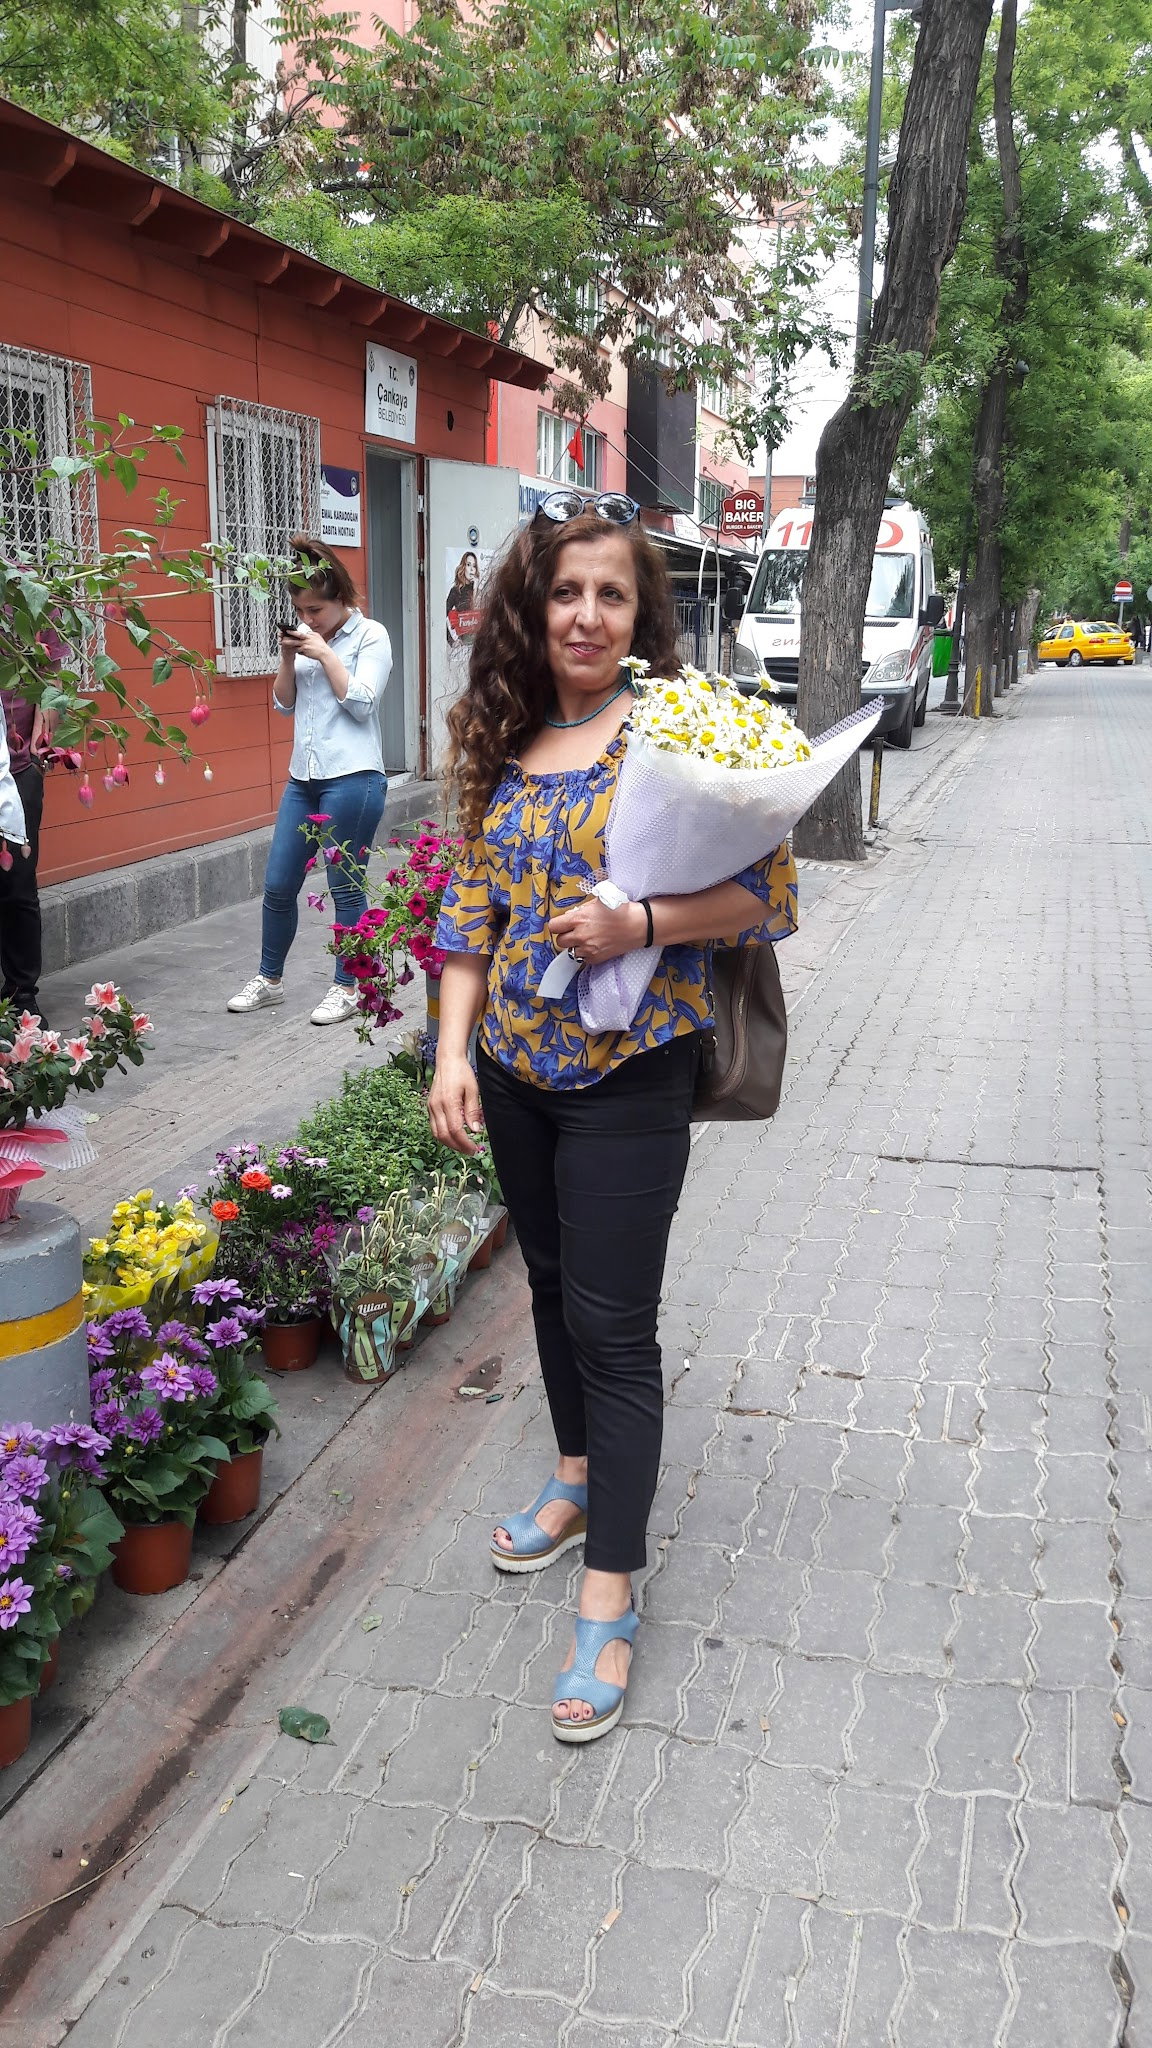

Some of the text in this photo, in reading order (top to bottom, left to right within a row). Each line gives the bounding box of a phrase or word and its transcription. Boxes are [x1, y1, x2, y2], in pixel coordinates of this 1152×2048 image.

[388, 365, 399, 382] T.C.
[377, 383, 408, 411] Çankaya
[377, 407, 407, 426] BELEDİYESİ
[735, 499, 756, 510] BIG
[726, 512, 764, 522] BAKER
[358, 1303, 387, 1316] Lilian
